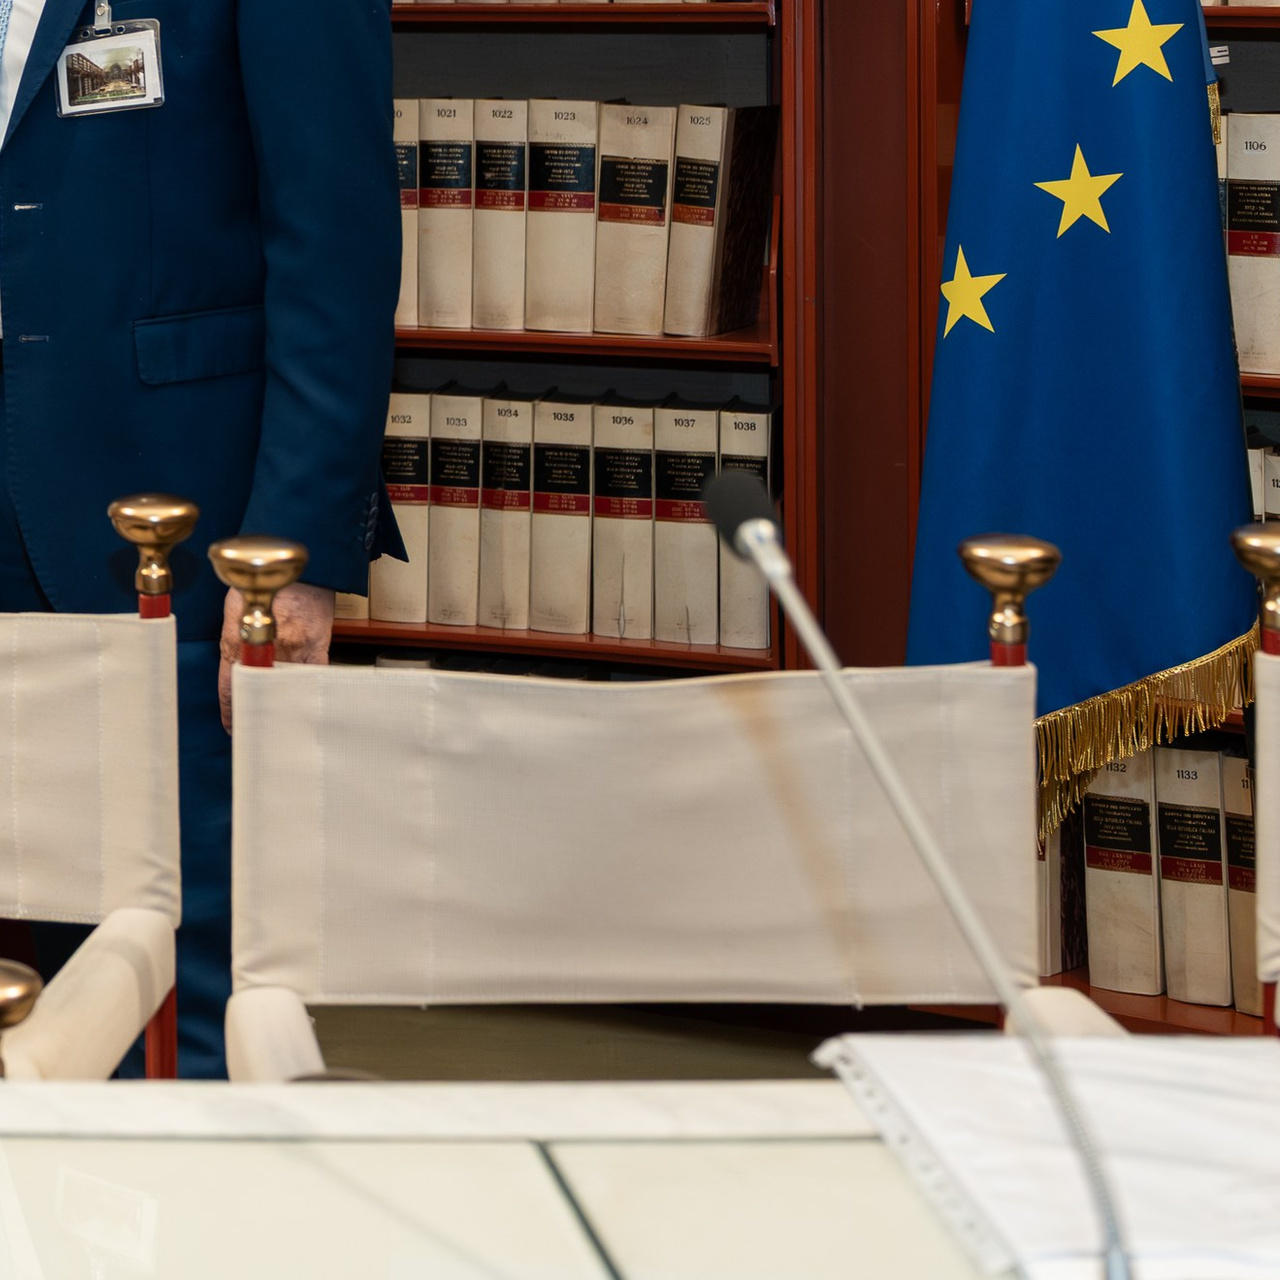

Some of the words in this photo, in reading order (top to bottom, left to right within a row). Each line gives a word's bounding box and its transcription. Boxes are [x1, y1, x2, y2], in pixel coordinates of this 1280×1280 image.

[437, 108, 456, 118] 1021
[492, 109, 513, 118] 1022
[554, 111, 576, 120] 1023
[626, 116, 648, 125] 1024
[690, 115, 711, 125] 1025
[1244, 140, 1267, 151] 1106
[497, 408, 519, 418] 1034
[553, 412, 575, 421] 1035
[390, 414, 412, 424] 1032
[446, 417, 467, 427] 1033
[611, 416, 634, 426] 1036
[674, 418, 696, 427] 1037
[733, 421, 756, 431] 1038
[1106, 762, 1127, 773] 1132
[1176, 769, 1198, 780] 1133
